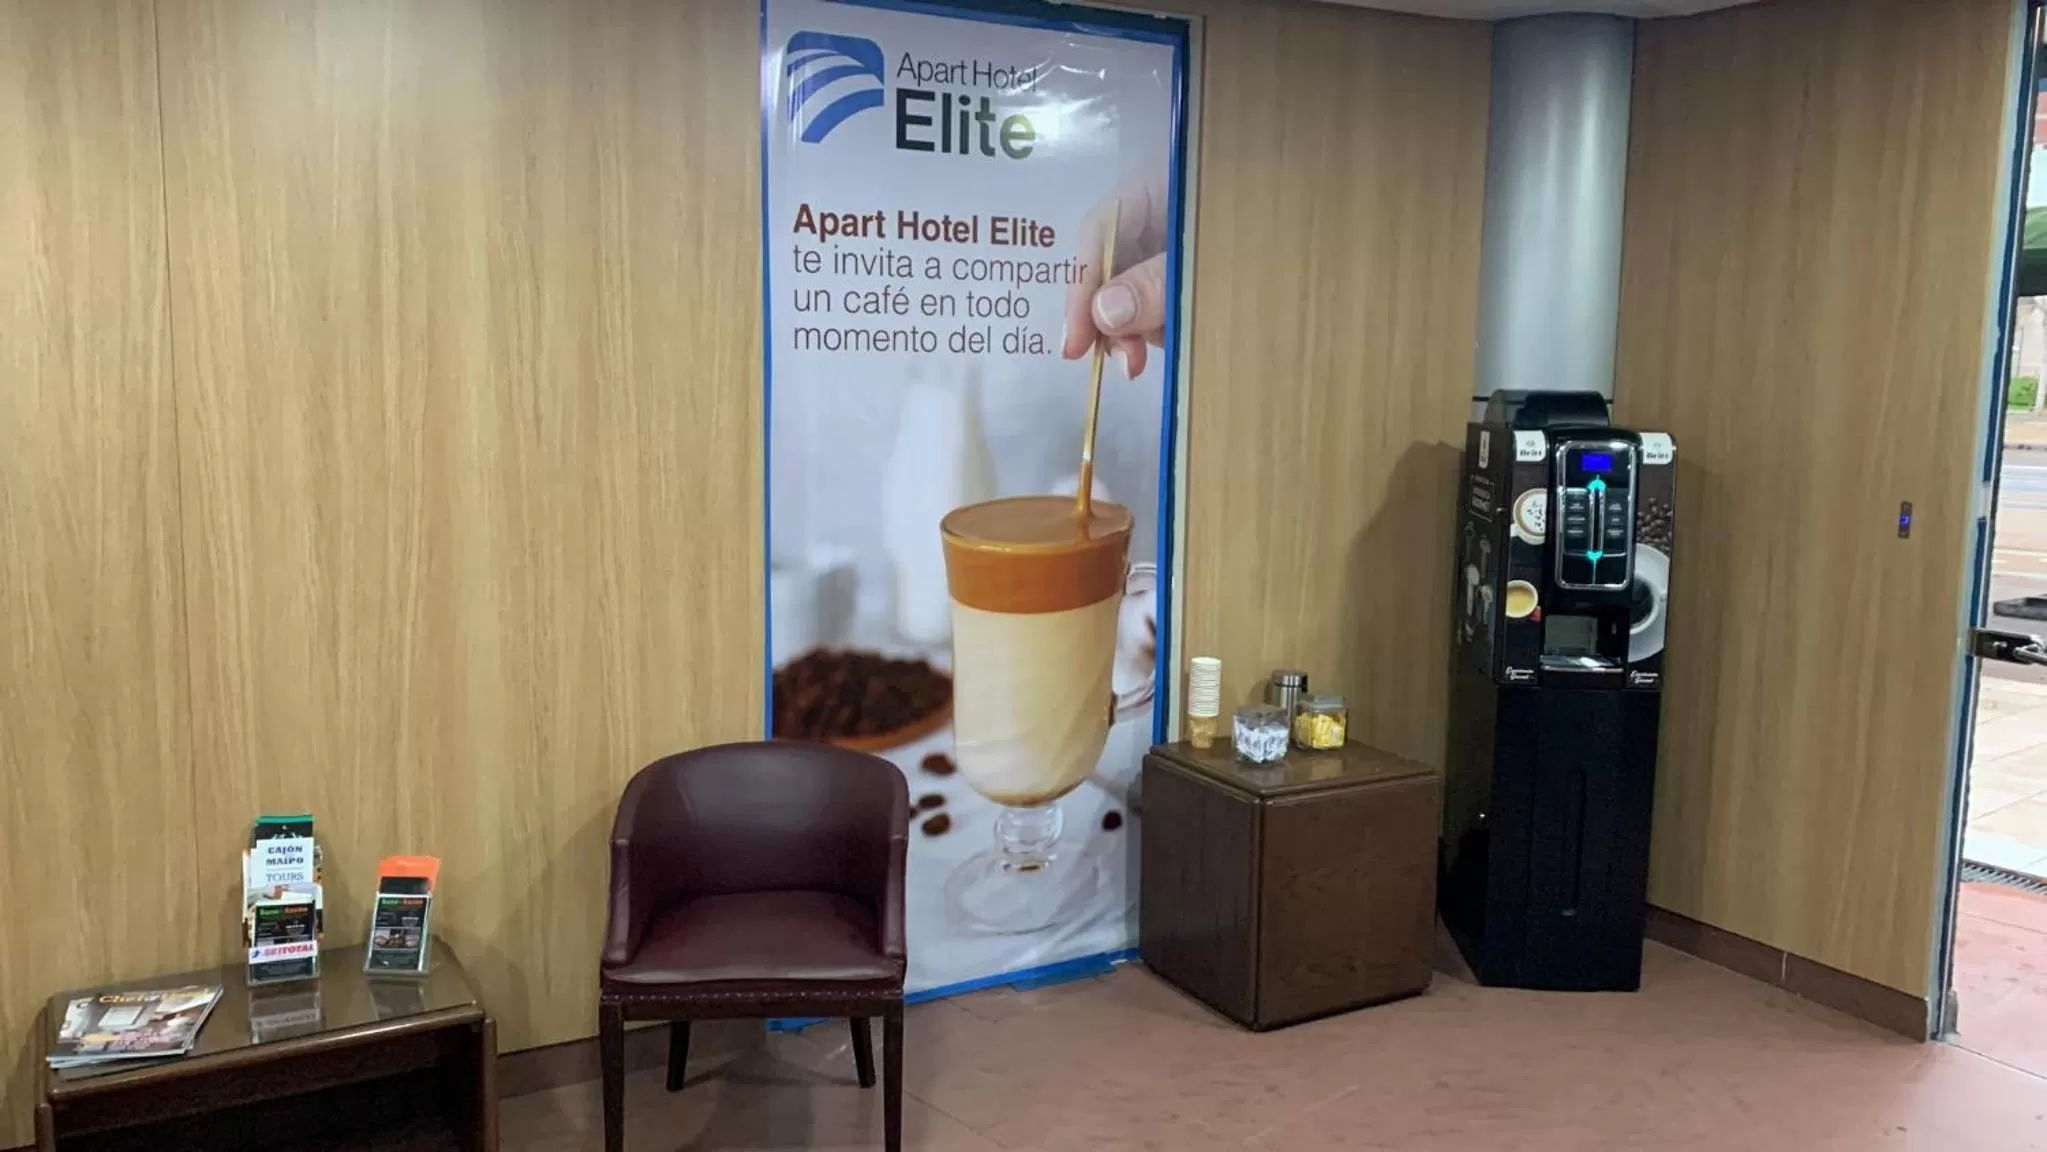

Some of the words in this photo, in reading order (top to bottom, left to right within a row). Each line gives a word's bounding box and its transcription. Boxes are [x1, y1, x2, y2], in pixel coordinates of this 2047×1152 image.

[896, 52, 968, 87] Apart
[972, 60, 1037, 93] Hotel
[895, 87, 1037, 160] Elite
[793, 203, 886, 242] Apart
[897, 210, 979, 244] Hotel
[990, 217, 1056, 248] Elite
[793, 244, 822, 275] te
[834, 244, 914, 279] invita
[924, 258, 942, 280] a
[952, 255, 1089, 288] compartir
[793, 288, 832, 314] un
[843, 285, 910, 316] café
[920, 292, 957, 318] en
[967, 290, 1031, 320] todo
[793, 325, 938, 355] momento
[948, 323, 992, 355] del
[1003, 325, 1053, 356] día.
[266, 872, 304, 883] TOURS
